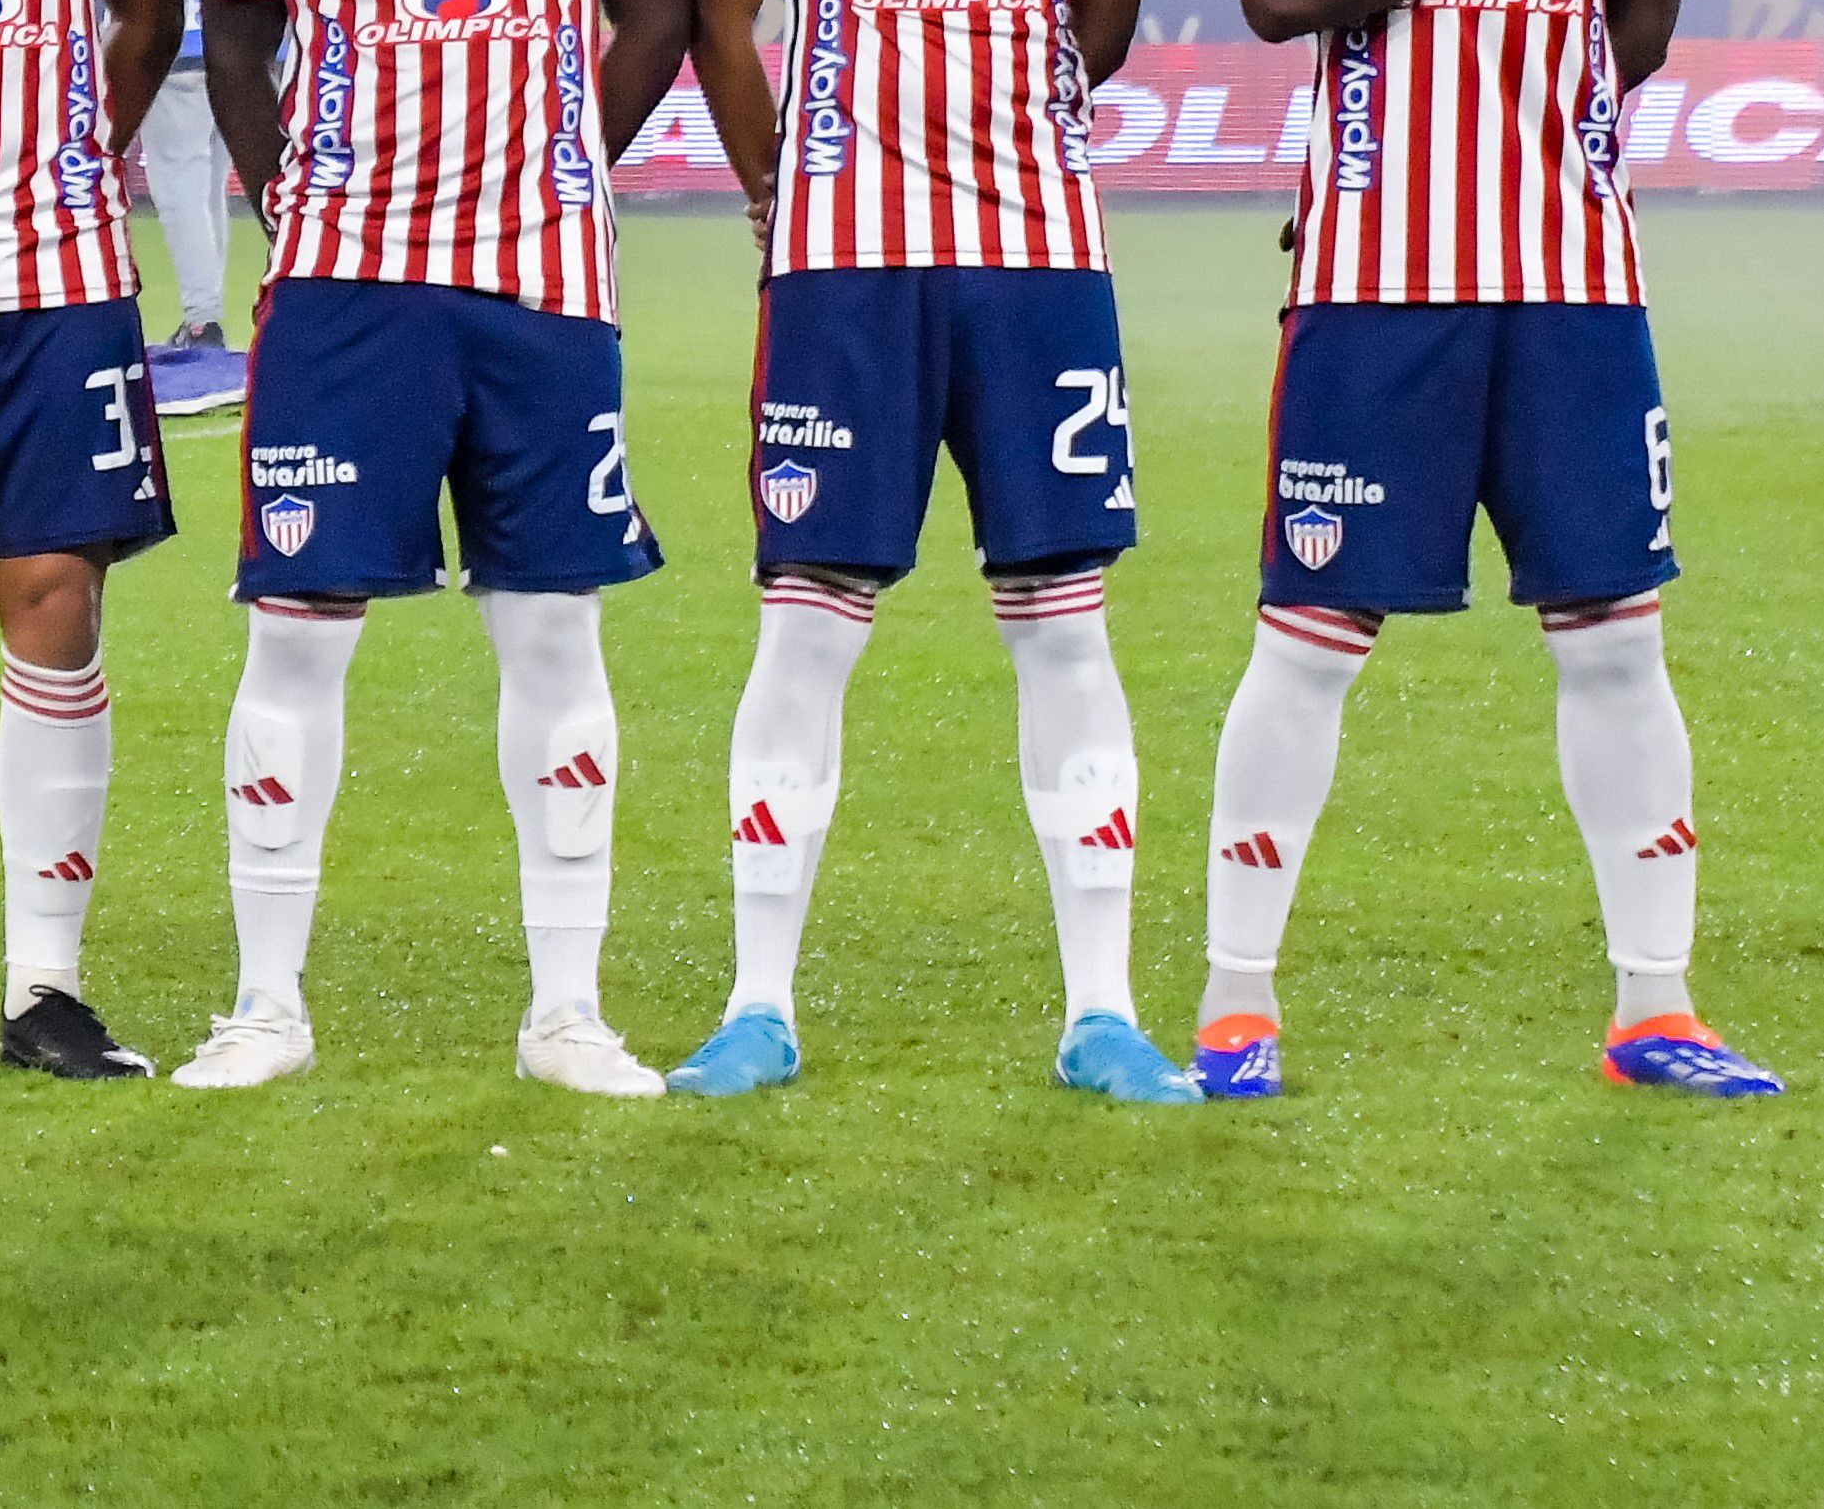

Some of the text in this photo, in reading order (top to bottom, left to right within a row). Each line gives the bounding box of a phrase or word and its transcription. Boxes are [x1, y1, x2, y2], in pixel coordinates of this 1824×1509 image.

[356, 16, 552, 47] OLIMPICA
[85, 364, 150, 471] 3
[1052, 367, 1135, 475] 24
[251, 457, 358, 488] brasilia
[1278, 474, 1386, 505] brasilia
